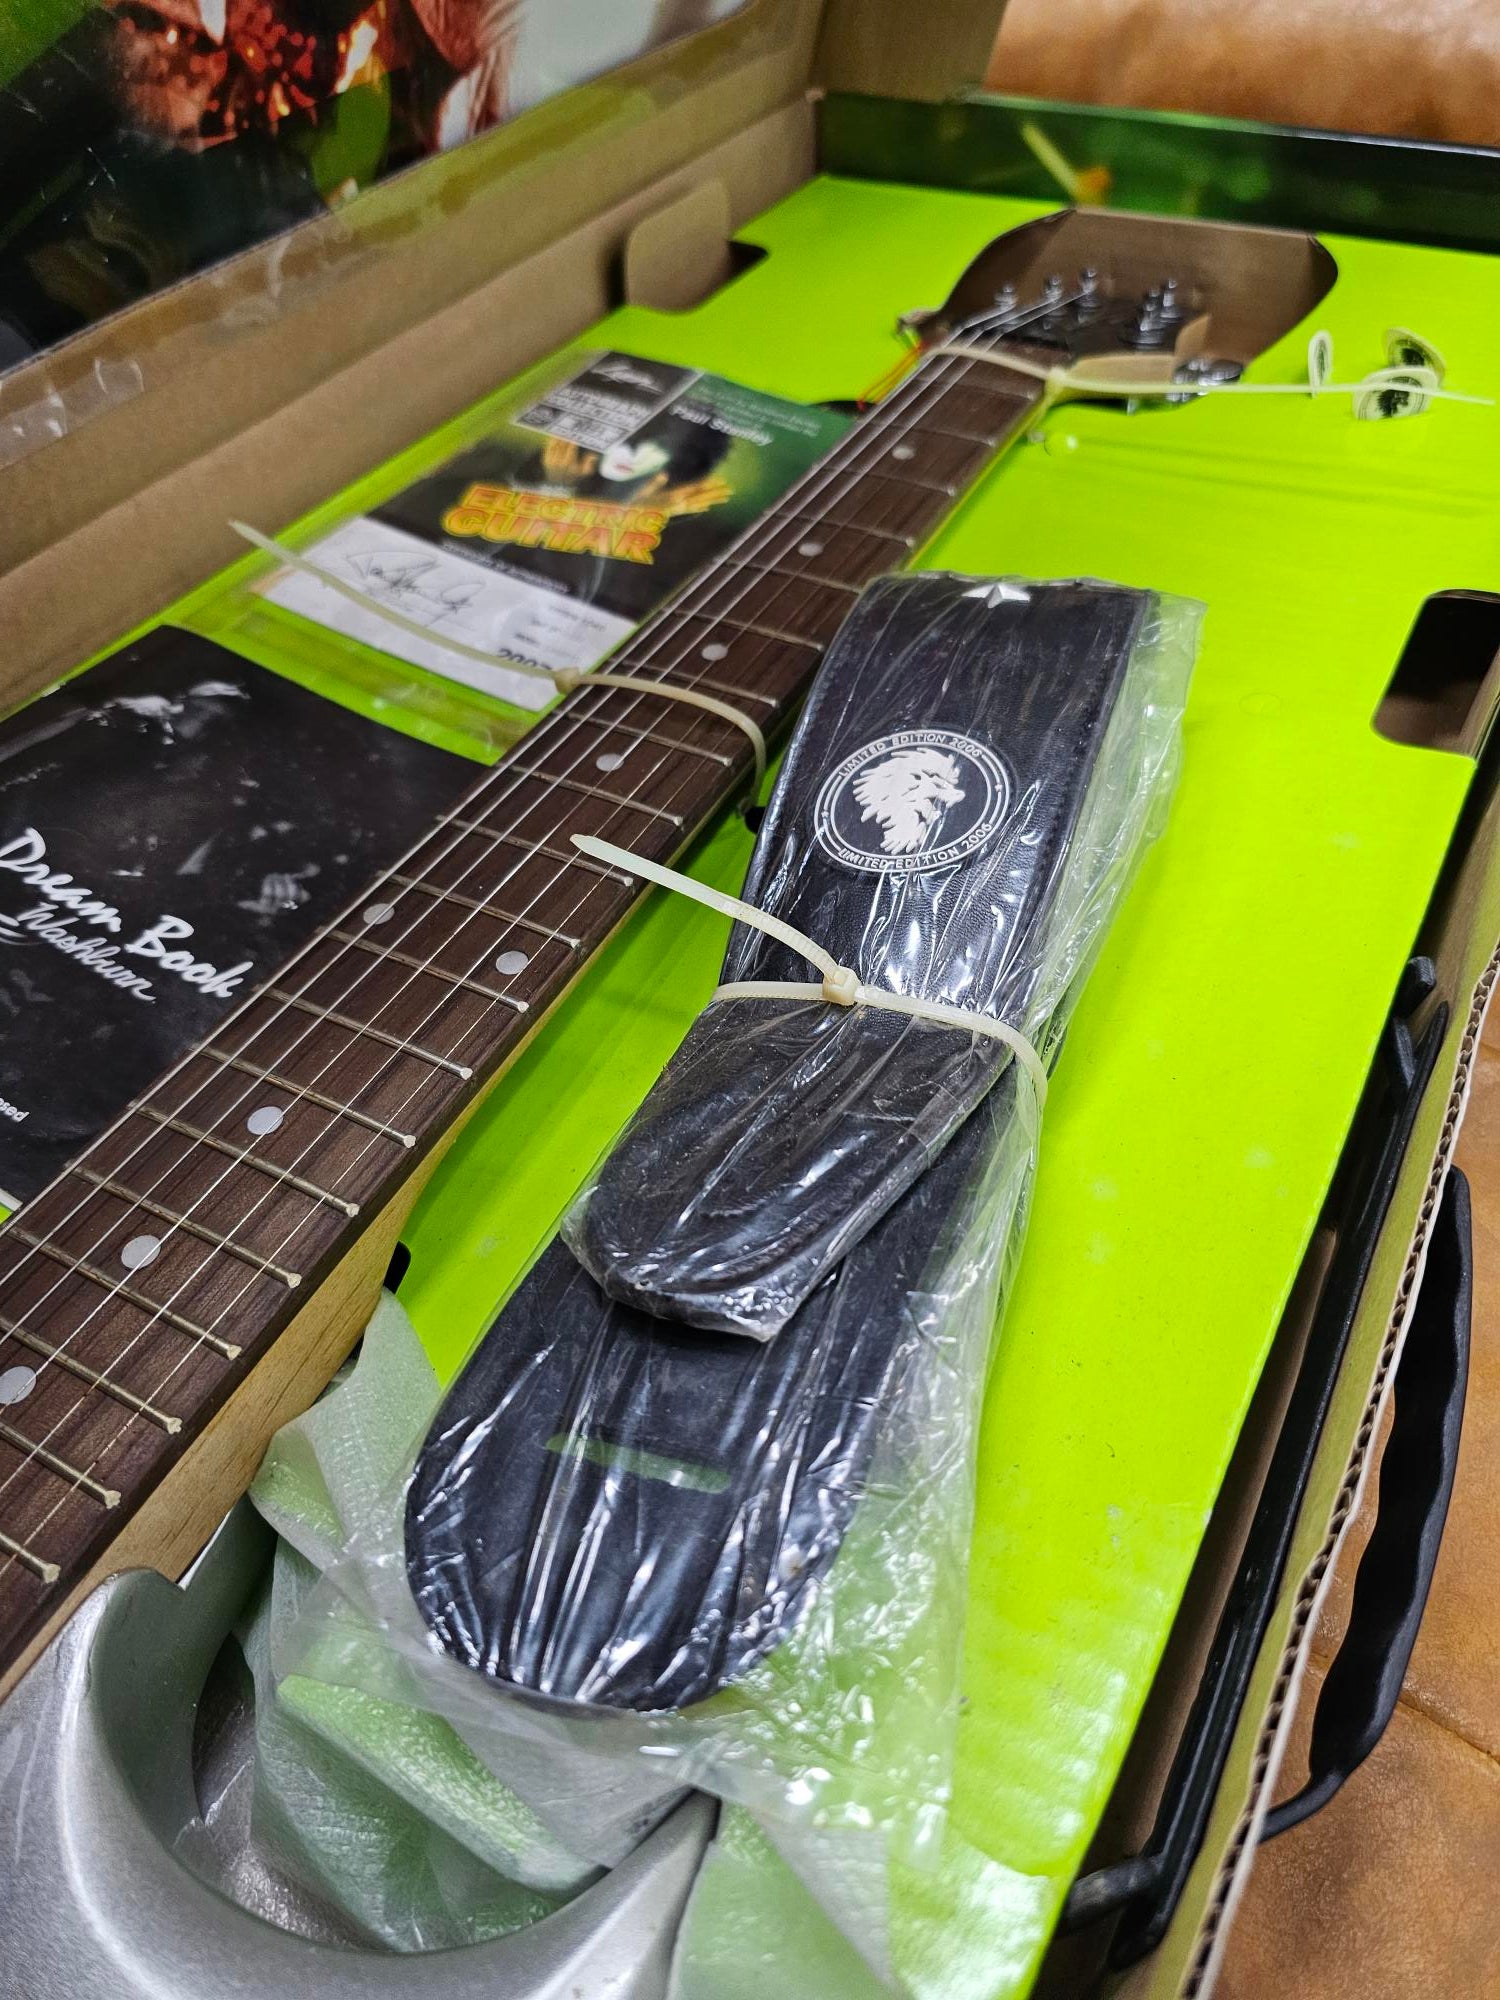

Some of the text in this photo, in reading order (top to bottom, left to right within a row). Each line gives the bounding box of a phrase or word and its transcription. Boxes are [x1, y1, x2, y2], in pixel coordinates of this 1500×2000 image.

[461, 483, 669, 532] ELECTRIC
[441, 505, 663, 566] GUITAR
[838, 733, 983, 777] LIMITED EDITION 2006
[838, 822, 993, 869] LIMITED EDITION 2006
[0, 827, 254, 998] Dream Book
[16, 902, 156, 1002] Washburn
